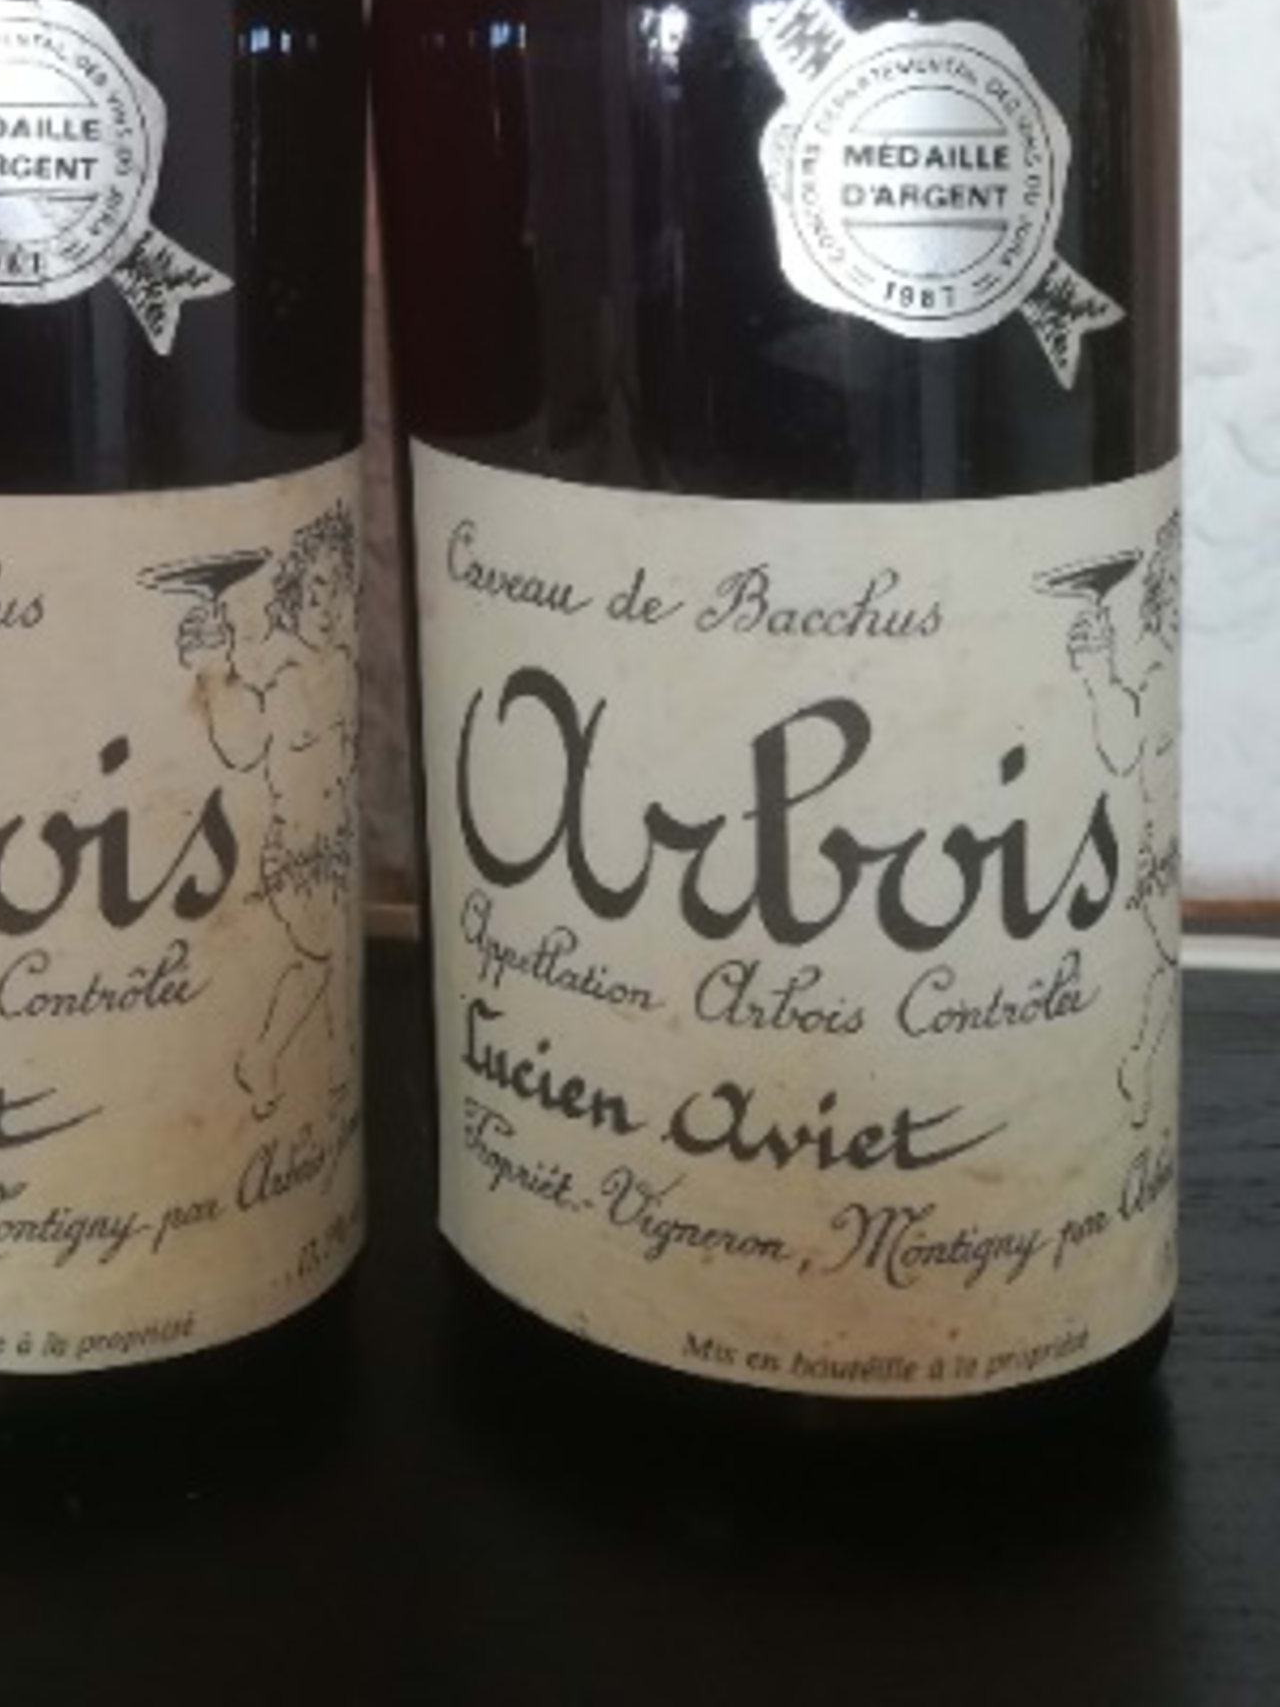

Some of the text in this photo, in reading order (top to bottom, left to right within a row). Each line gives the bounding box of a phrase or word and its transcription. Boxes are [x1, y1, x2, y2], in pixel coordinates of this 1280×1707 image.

[840, 183, 1008, 209] D'ARGENT
[446, 519, 943, 638] Caveau de Bacchus
[456, 666, 1120, 951] Arbois
[459, 888, 664, 1012] Appellation
[693, 959, 865, 1032] Arbois
[460, 998, 1009, 1171] Lucien Aviet
[159, 1199, 229, 1254] par
[824, 1203, 1054, 1288] Montigny
[1052, 1212, 1112, 1271] par
[16, 1330, 31, 1356] à
[42, 1330, 69, 1359] la
[681, 1332, 736, 1366] Mis
[745, 1350, 781, 1373] en
[791, 1350, 919, 1383] bouteille
[928, 1356, 946, 1382] à
[954, 1354, 980, 1379] la
